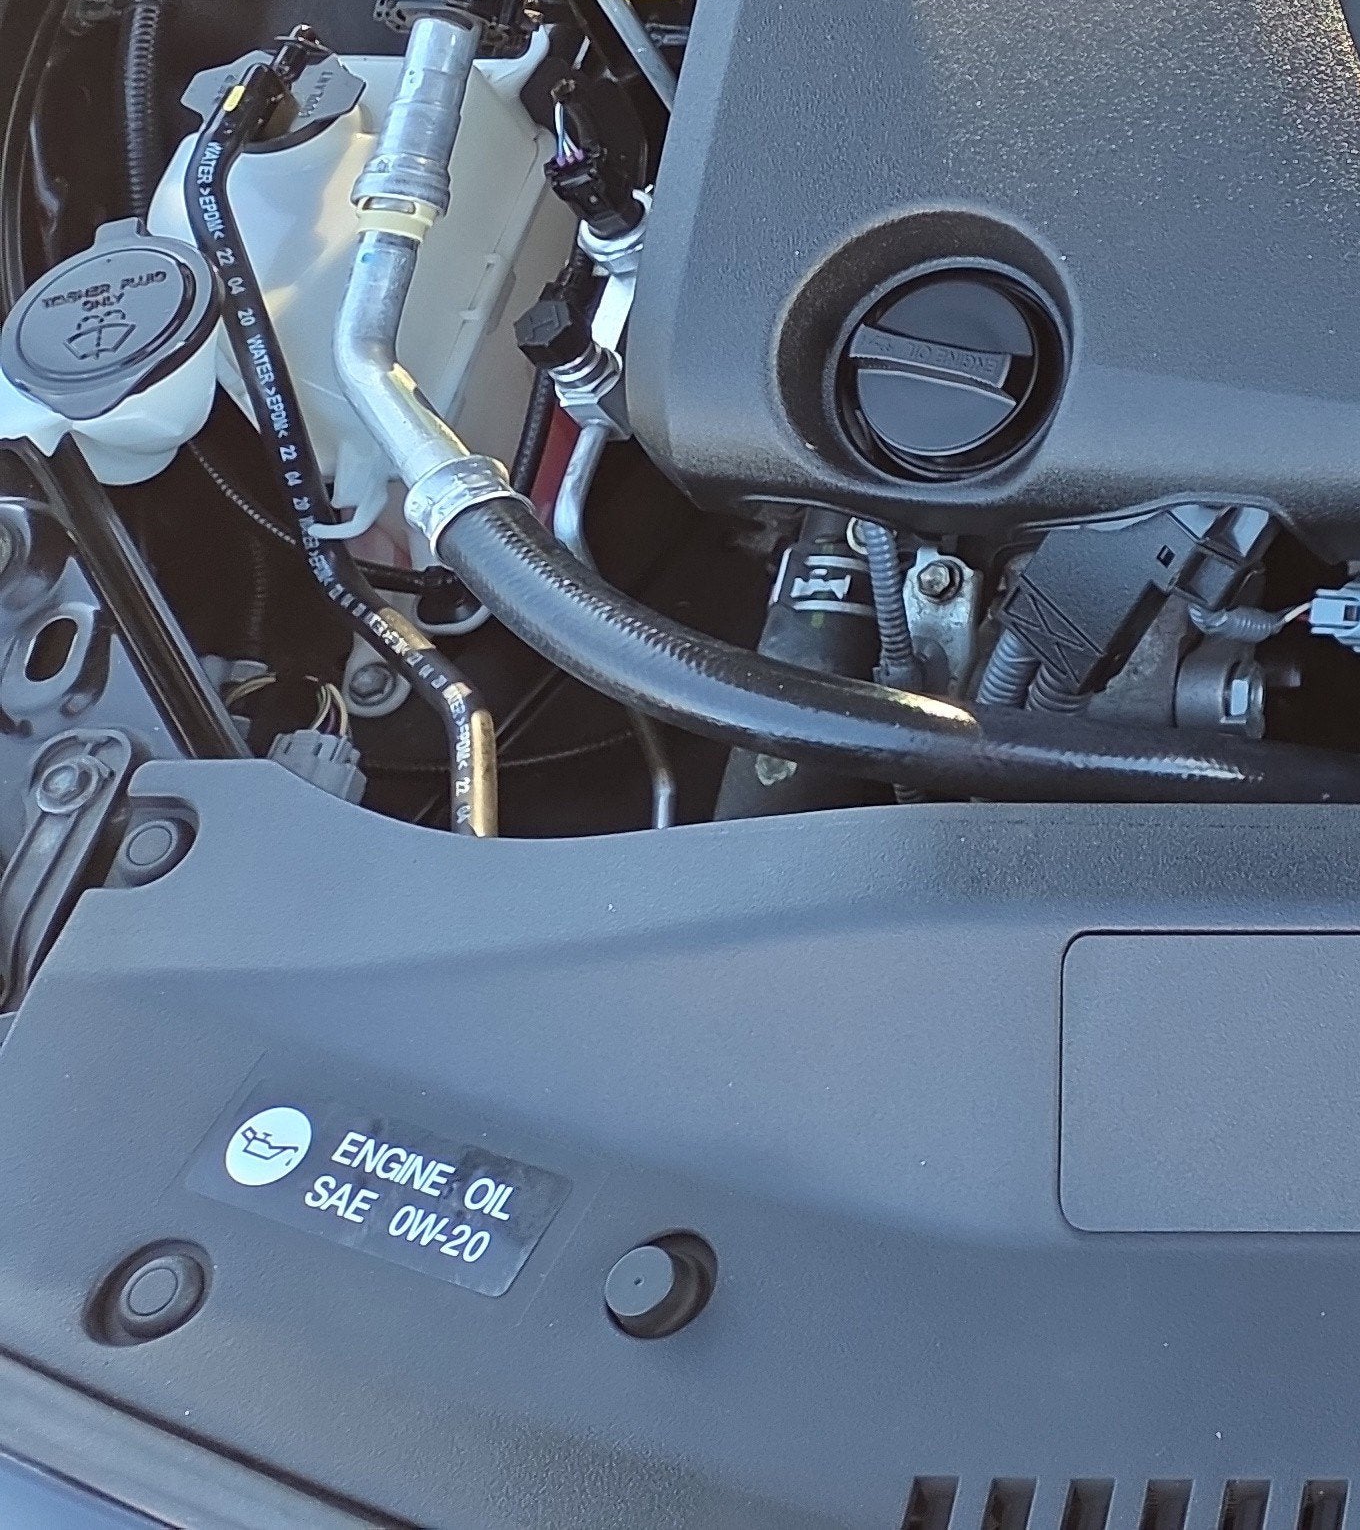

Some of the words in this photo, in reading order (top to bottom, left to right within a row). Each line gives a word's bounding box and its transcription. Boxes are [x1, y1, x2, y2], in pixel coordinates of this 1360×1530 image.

[81, 291, 125, 312] ONLY
[197, 141, 223, 185] WATER
[216, 247, 235, 266] 22
[227, 276, 246, 295] 04
[237, 308, 256, 327] 20
[247, 334, 275, 386] WATER
[304, 1175, 380, 1223] SAE
[388, 1205, 491, 1263] 0W-20
[331, 1131, 456, 1197] ENGINE
[463, 1177, 515, 1221] OIL
